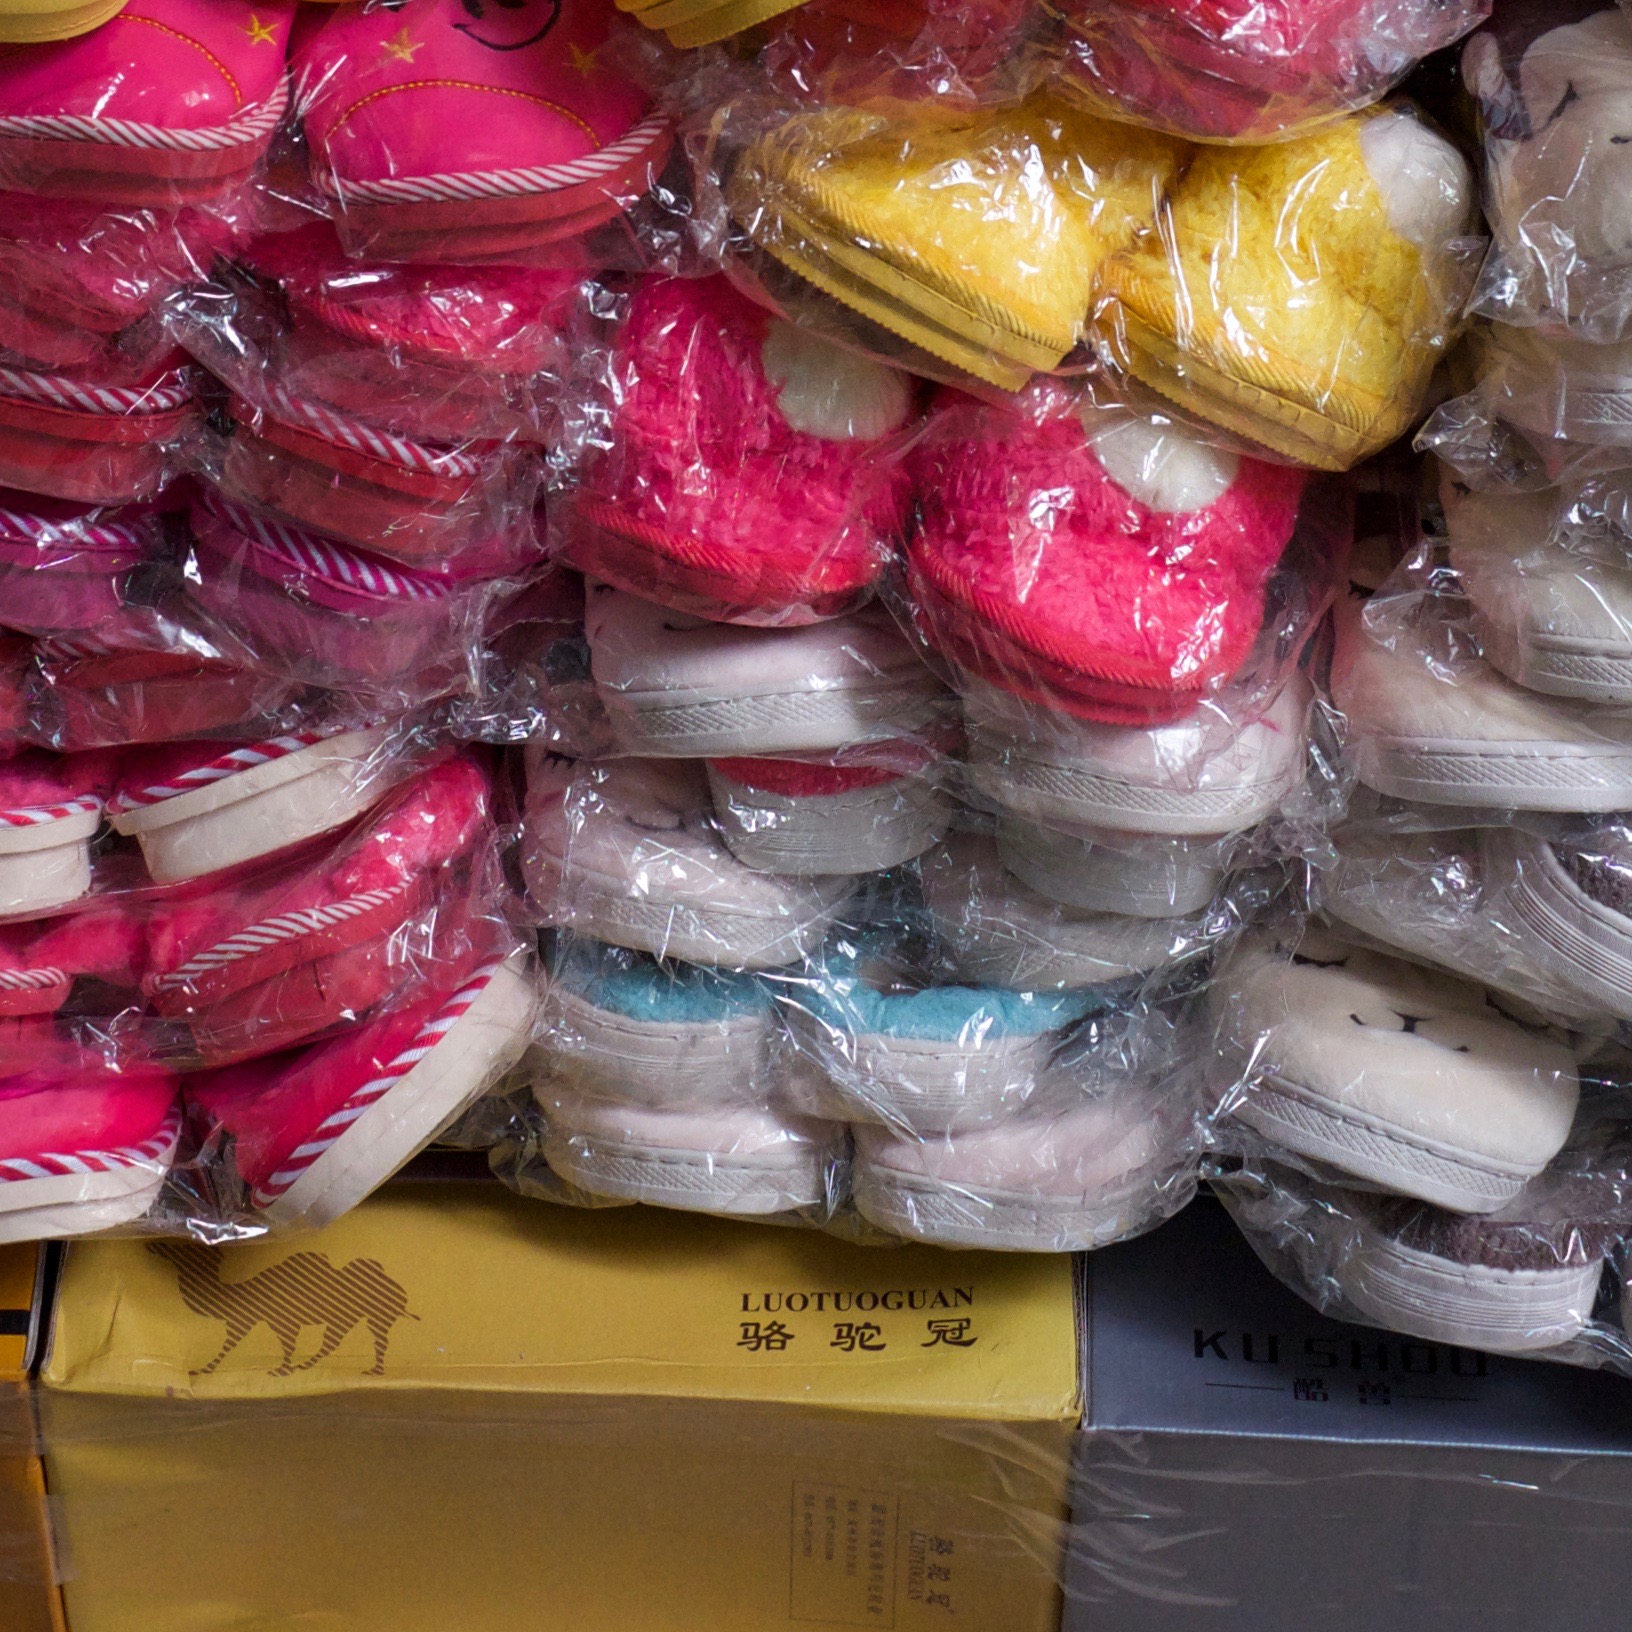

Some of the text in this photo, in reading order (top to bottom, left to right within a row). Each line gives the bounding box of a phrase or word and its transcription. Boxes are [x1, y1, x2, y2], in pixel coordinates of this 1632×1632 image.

[740, 1286, 974, 1312] LUOTUOGUAN
[737, 1318, 978, 1351] 骆驼冠
[1194, 1328, 1279, 1364] KU
